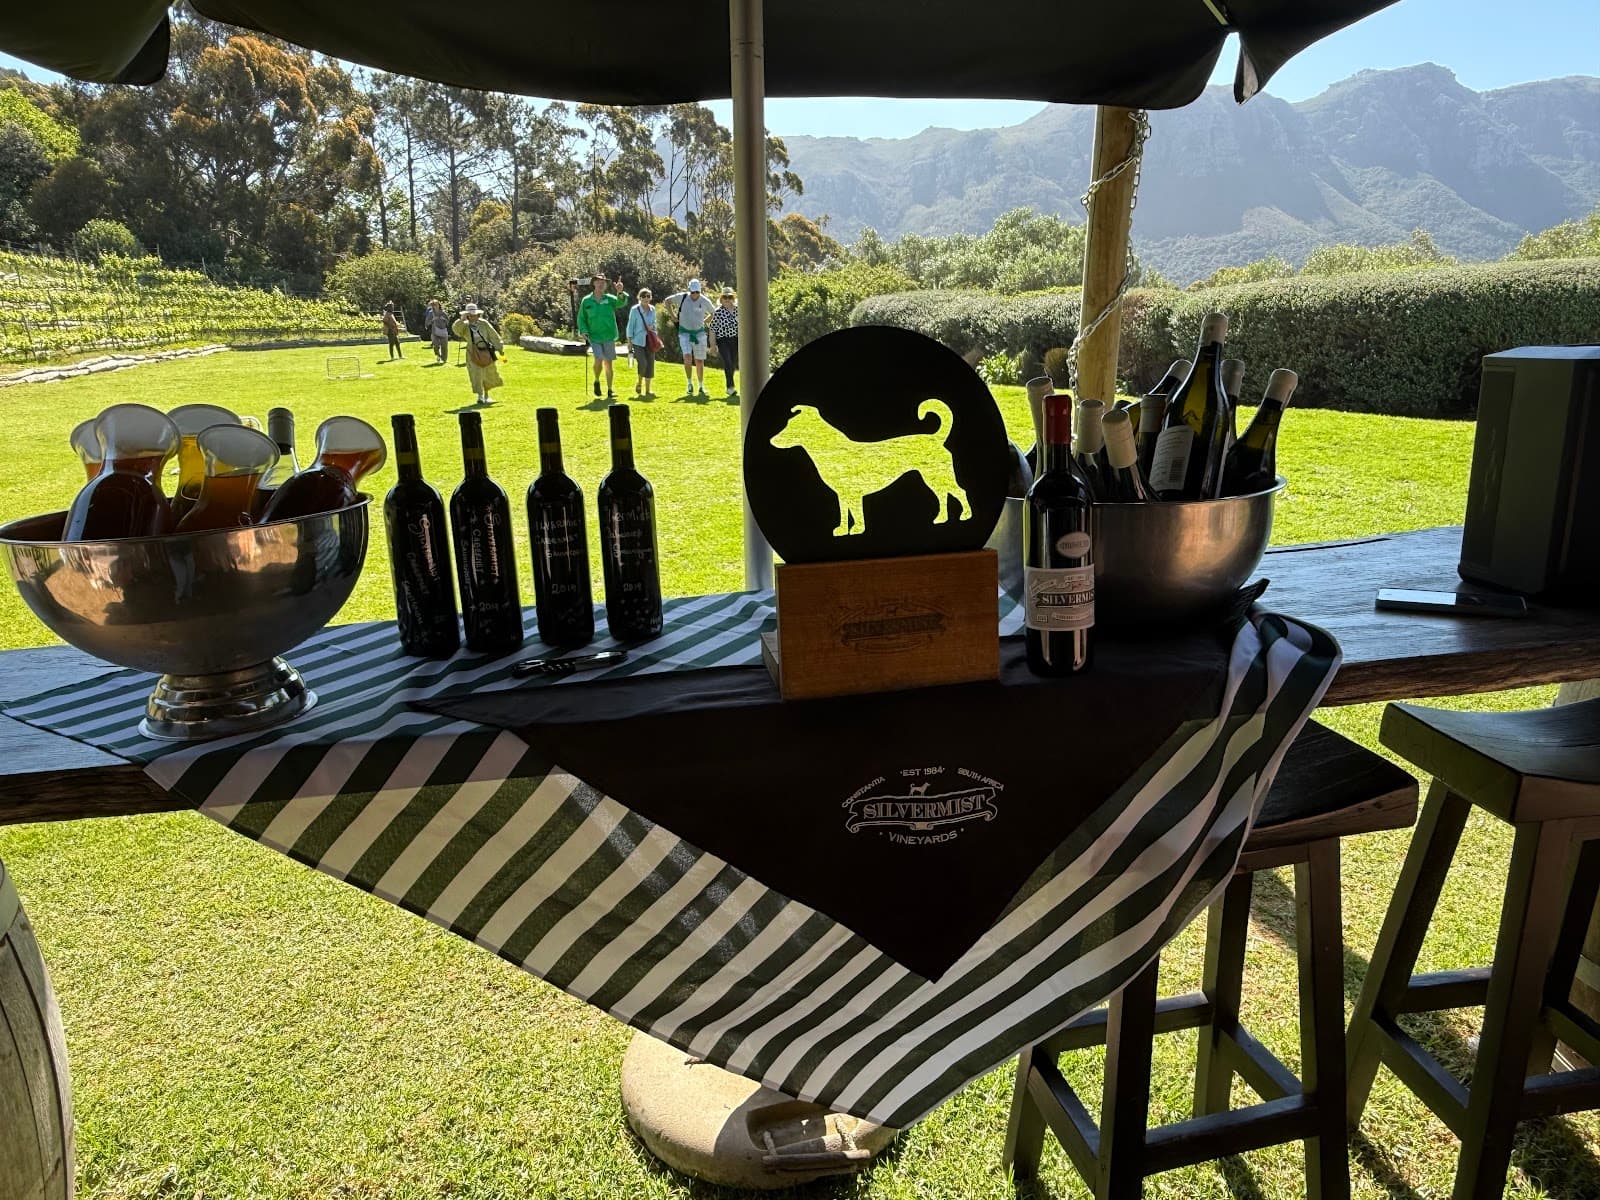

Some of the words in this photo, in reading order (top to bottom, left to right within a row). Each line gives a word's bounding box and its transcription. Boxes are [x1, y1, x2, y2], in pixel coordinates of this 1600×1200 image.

[841, 776, 886, 808] CONSTANTIA
[957, 767, 982, 781] SOUTH
[981, 775, 1005, 792] AFRICA
[862, 794, 986, 819] SILVERMIST
